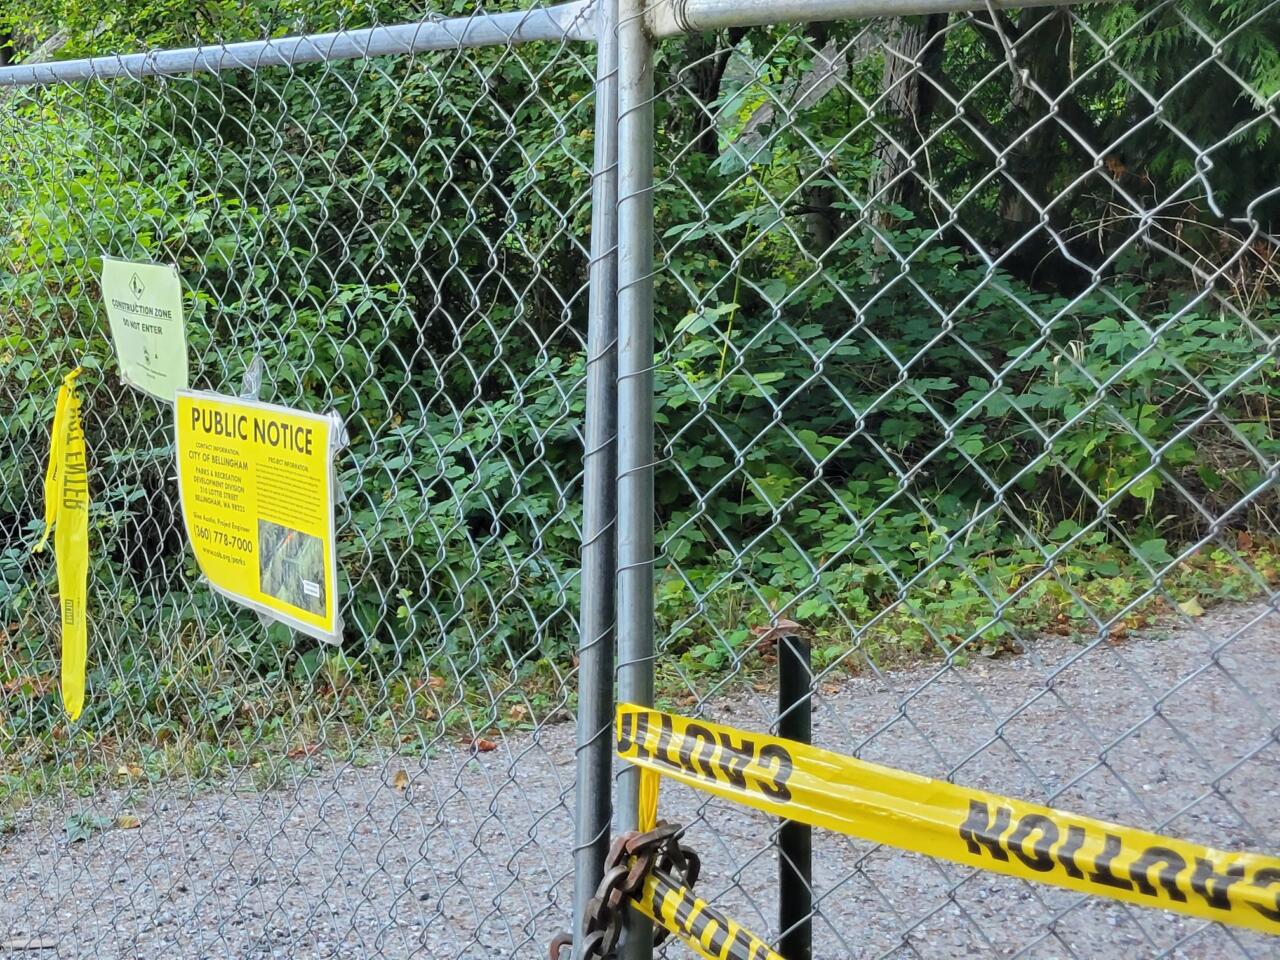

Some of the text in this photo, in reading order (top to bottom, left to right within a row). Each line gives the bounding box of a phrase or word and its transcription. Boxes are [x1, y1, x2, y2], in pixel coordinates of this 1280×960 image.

[111, 299, 172, 319] CONSTRUCTION ZONE
[123, 317, 163, 335] DO NOT ENTER
[192, 407, 312, 455] PUBLIC NOTICE
[189, 450, 248, 471] CITY OF BELLINGHAM
[195, 466, 209, 475] PARKS
[214, 471, 242, 483] RECREATION
[194, 475, 245, 494] DEVELOPMENT DIVISION
[223, 491, 238, 501] STREET
[194, 524, 252, 553] (360) 778-7000
